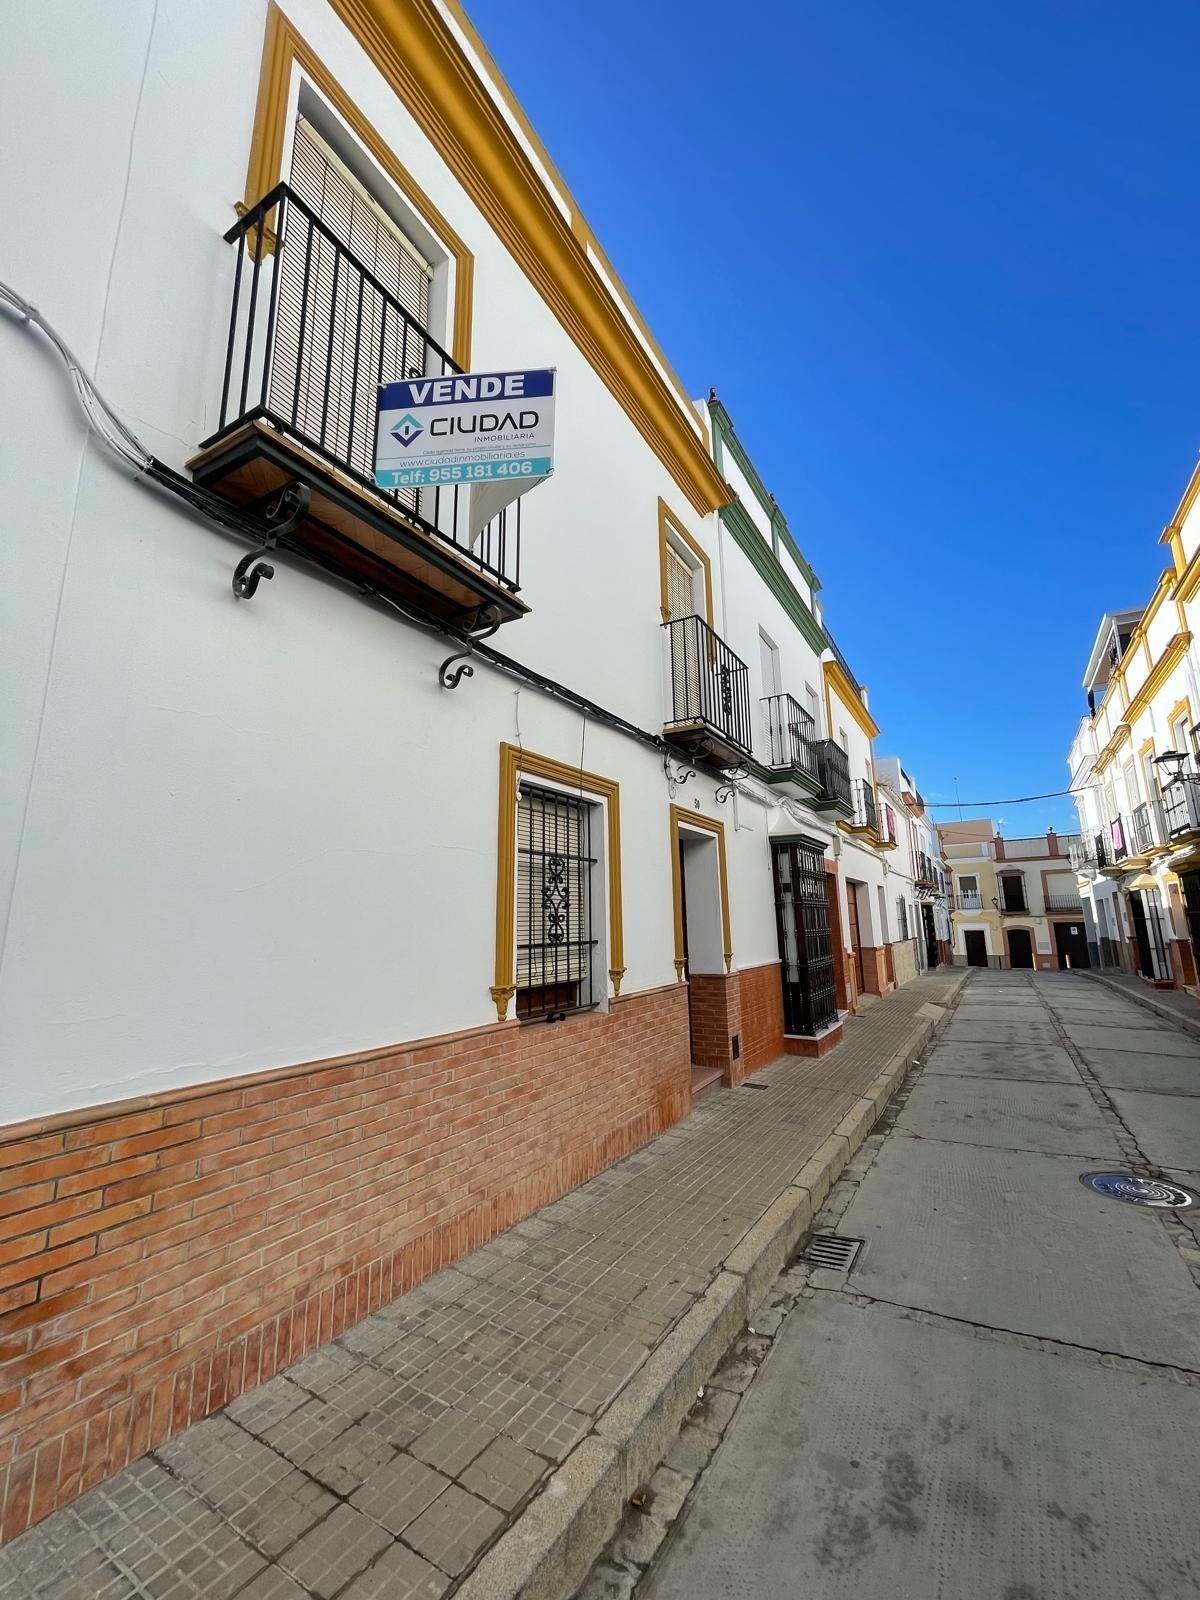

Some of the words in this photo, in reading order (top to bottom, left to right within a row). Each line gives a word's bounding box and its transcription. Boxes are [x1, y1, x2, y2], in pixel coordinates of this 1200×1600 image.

[408, 374, 525, 405] VENDE
[430, 410, 539, 437] CIUDAD
[474, 432, 535, 443] INMOBILIARIA
[399, 450, 526, 468] www.ciudadinmobiliaria.es
[391, 472, 425, 485] Telf:
[429, 468, 462, 482] 955
[467, 465, 493, 478] 181
[497, 461, 533, 475] 406
